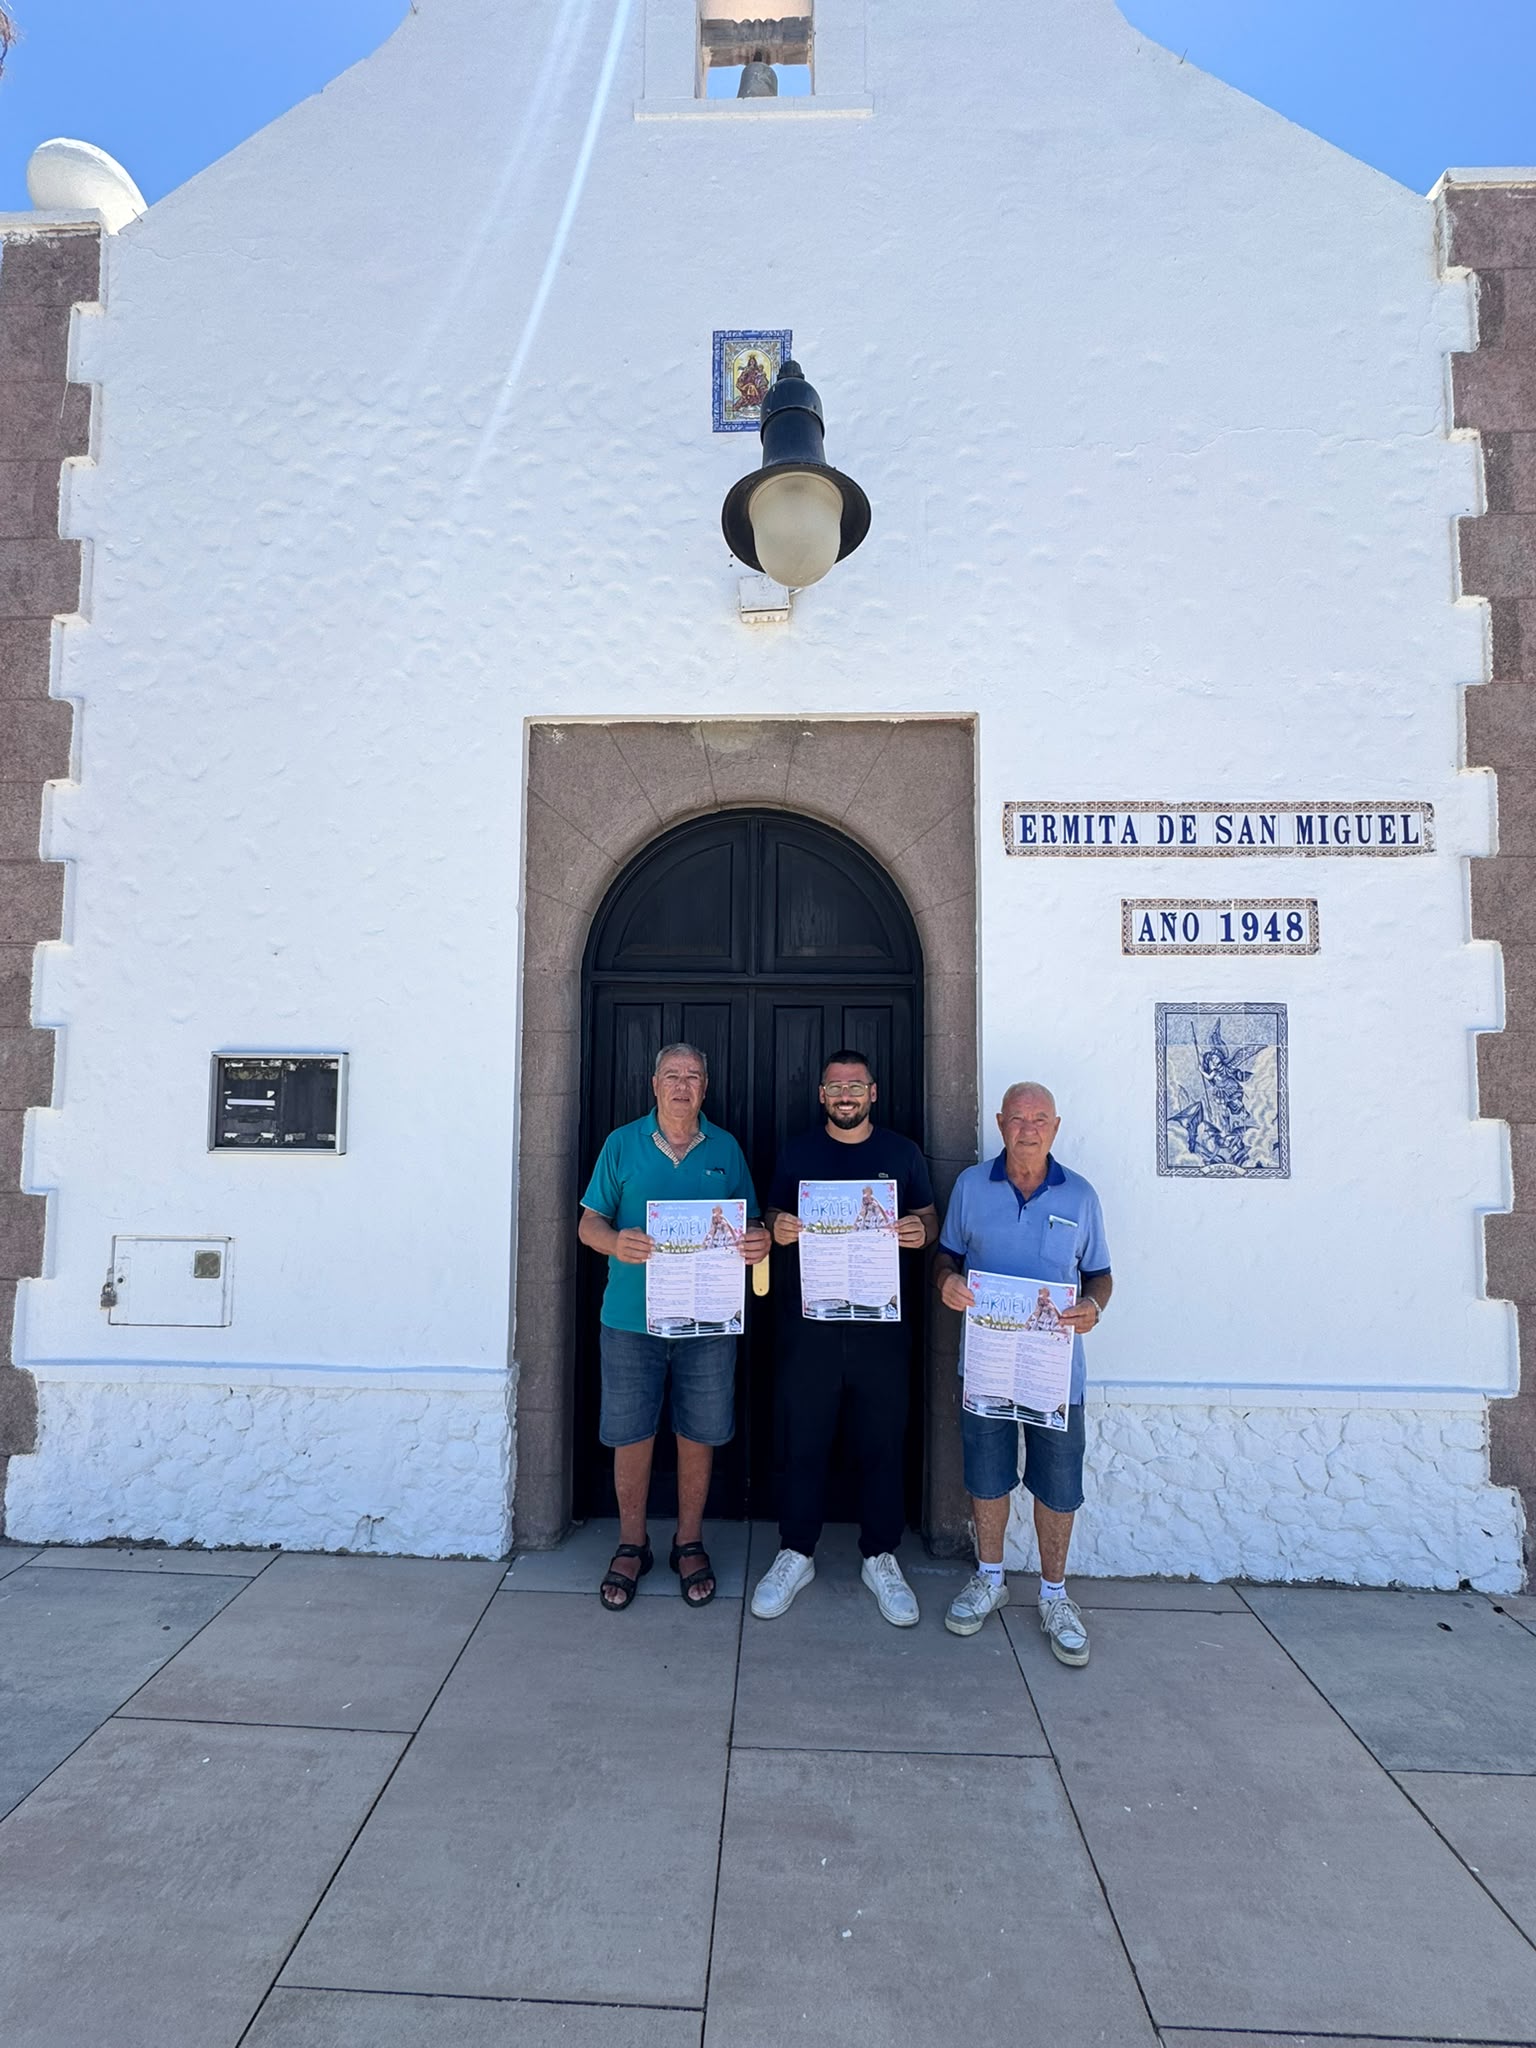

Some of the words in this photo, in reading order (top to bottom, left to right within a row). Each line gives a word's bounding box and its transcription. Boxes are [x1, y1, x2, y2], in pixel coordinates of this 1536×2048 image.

[1019, 814, 1138, 844] ERMITA
[1156, 814, 1197, 844] DE
[1215, 814, 1276, 844] SAN
[1295, 814, 1419, 844] MIGUEL
[1138, 910, 1200, 942] AÑO
[1220, 911, 1304, 942] 1948
[802, 1198, 858, 1217] CARMEN
[651, 1218, 708, 1237] CARMEN
